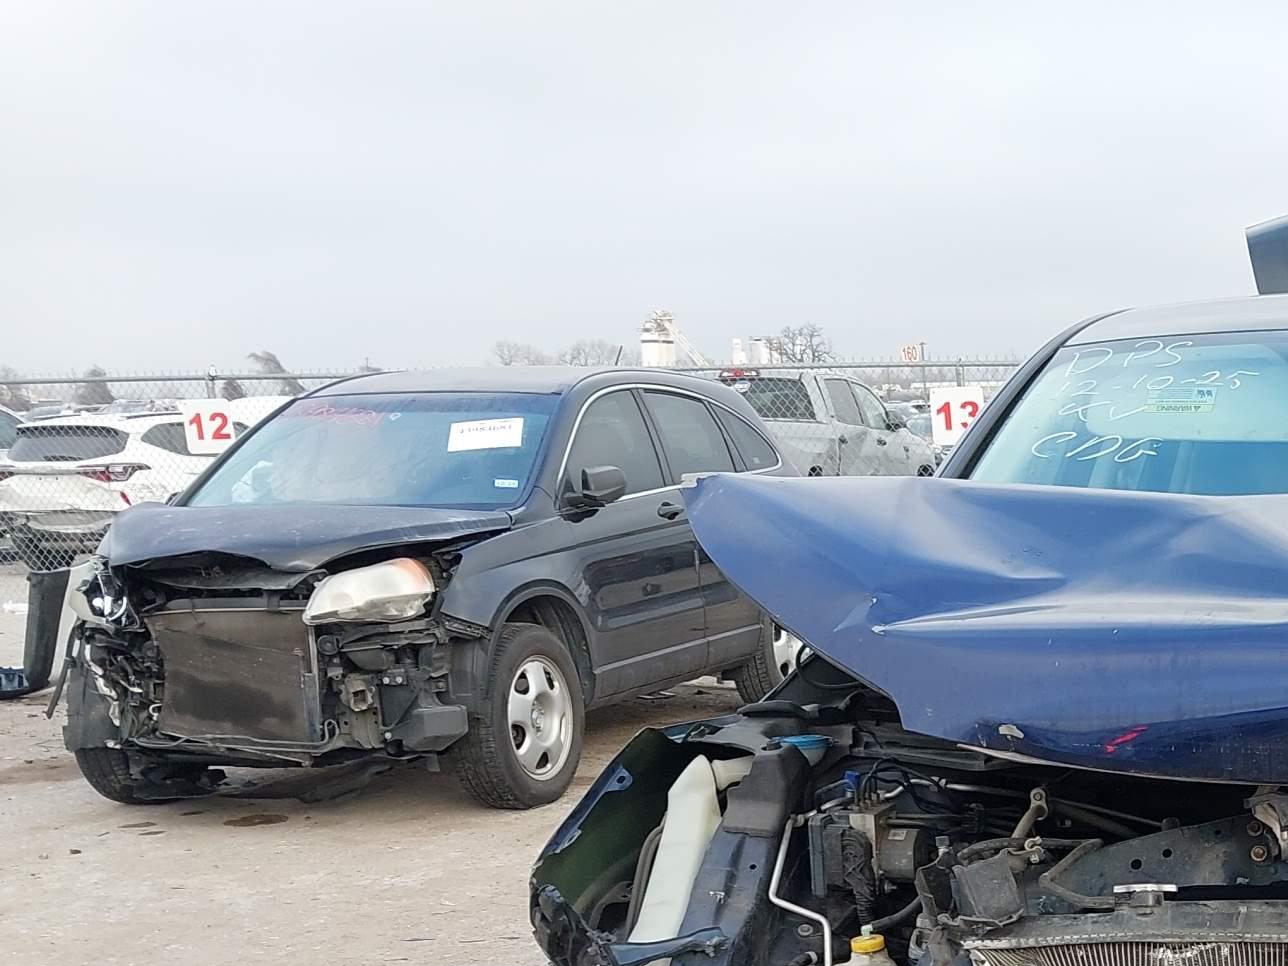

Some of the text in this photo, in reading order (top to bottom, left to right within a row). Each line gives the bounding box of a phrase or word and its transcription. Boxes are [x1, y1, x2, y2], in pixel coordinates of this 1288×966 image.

[1065, 340, 1193, 377] DPS
[189, 412, 231, 441] 12
[936, 400, 979, 431] 13
